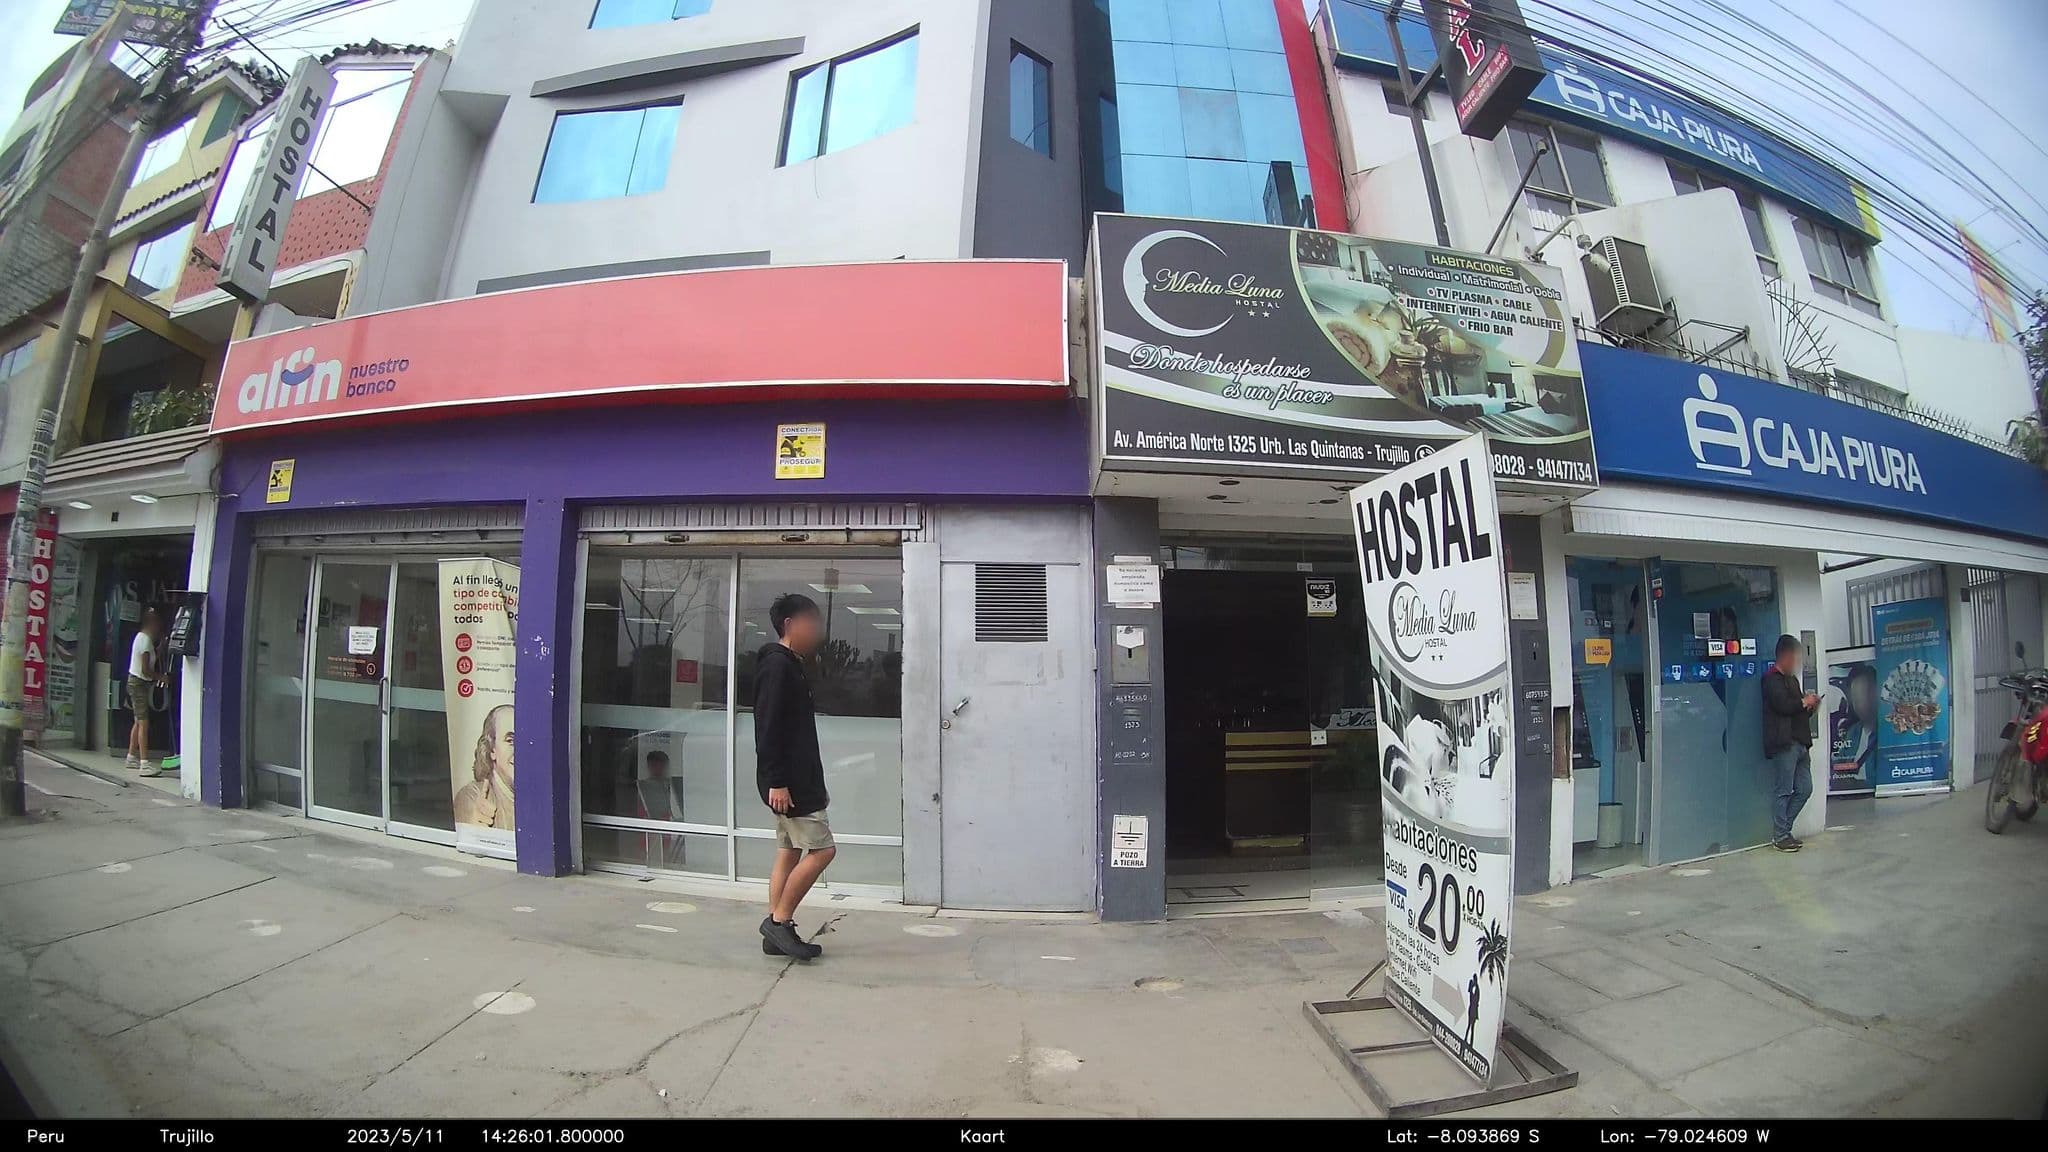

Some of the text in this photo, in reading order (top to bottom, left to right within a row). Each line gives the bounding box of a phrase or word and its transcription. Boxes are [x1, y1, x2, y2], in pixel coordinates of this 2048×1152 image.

[1608, 90, 1763, 172] CAJA PIURA
[248, 86, 323, 272] HOSTAL
[1431, 253, 1514, 277] HABITACIONES
[1153, 268, 1285, 300] Media Luna
[1398, 264, 1562, 301] Individual Matrimonial Doble
[1235, 299, 1281, 309] HOSTAL
[1436, 287, 1533, 312] TV PLASMA CABLE
[1406, 298, 1564, 331] INTERNET WIFI AGUA CALIENTE
[1468, 320, 1514, 337] FRIO BAR
[350, 357, 410, 380] nuestro
[1128, 343, 1312, 384] Donde hospedarse
[238, 346, 343, 413] alfin
[345, 378, 397, 398] banco
[1222, 380, 1334, 411] es un placer
[1113, 429, 1133, 448] Av.
[1136, 430, 1187, 450] América
[1190, 433, 1225, 452] Norte
[1227, 434, 1256, 453] 1325
[1260, 436, 1285, 455] Urb.
[1288, 438, 1308, 456] Las
[1310, 439, 1365, 460] Quintanas
[1374, 444, 1410, 466] Trujillo
[1536, 457, 1593, 483] 941477134
[1752, 416, 1928, 496] CAJA PIURA
[1356, 457, 1492, 584] HOSTAL
[453, 575, 463, 585] Al
[466, 574, 480, 585] fin
[505, 583, 518, 594] un
[453, 588, 475, 600] tipo
[477, 588, 489, 598] de
[24, 537, 54, 689] HOSTAL
[454, 613, 484, 624] todos
[1396, 588, 1478, 638] Media Luna
[1424, 637, 1448, 648] HOSTAL
[1710, 643, 1723, 651] VISA
[1120, 851, 1139, 859] POZO
[1385, 818, 1477, 873] abitaciones
[1120, 859, 1144, 867] TIERRA
[1385, 852, 1407, 879] Desde
[1389, 889, 1406, 913] VISA
[1408, 934, 1417, 949] las
[1416, 939, 1423, 953] 24
[1424, 942, 1440, 966] horas
